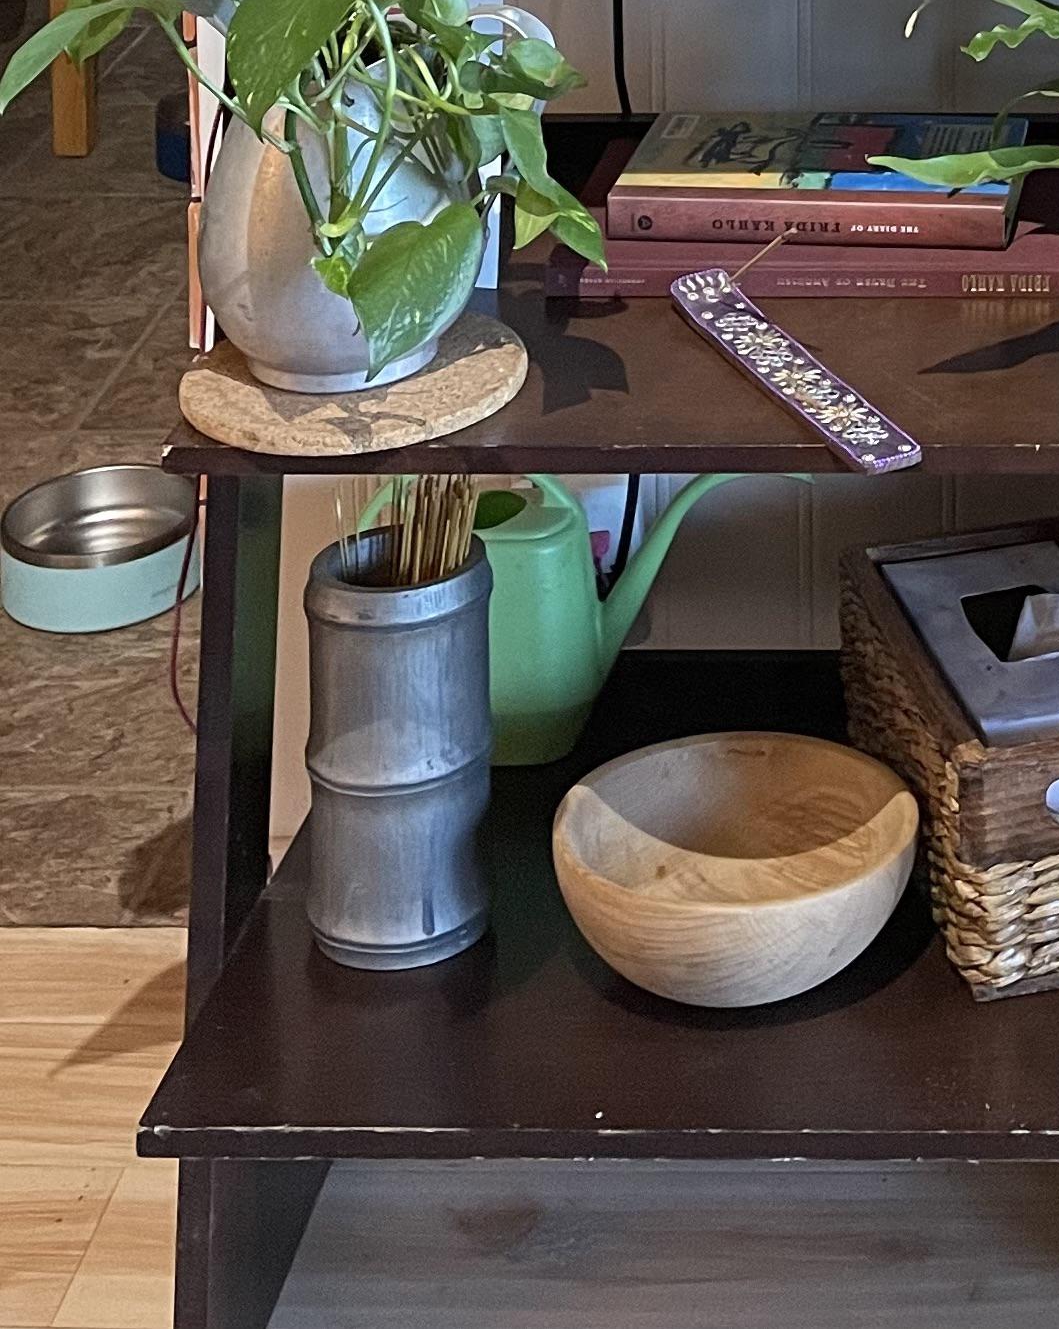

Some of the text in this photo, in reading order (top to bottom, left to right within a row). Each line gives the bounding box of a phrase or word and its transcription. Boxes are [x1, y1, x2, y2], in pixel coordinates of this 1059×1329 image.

[711, 219, 920, 234] THE DIARY OF FRIDA KAHLO
[960, 274, 1051, 293] FRIDA KAHLO
